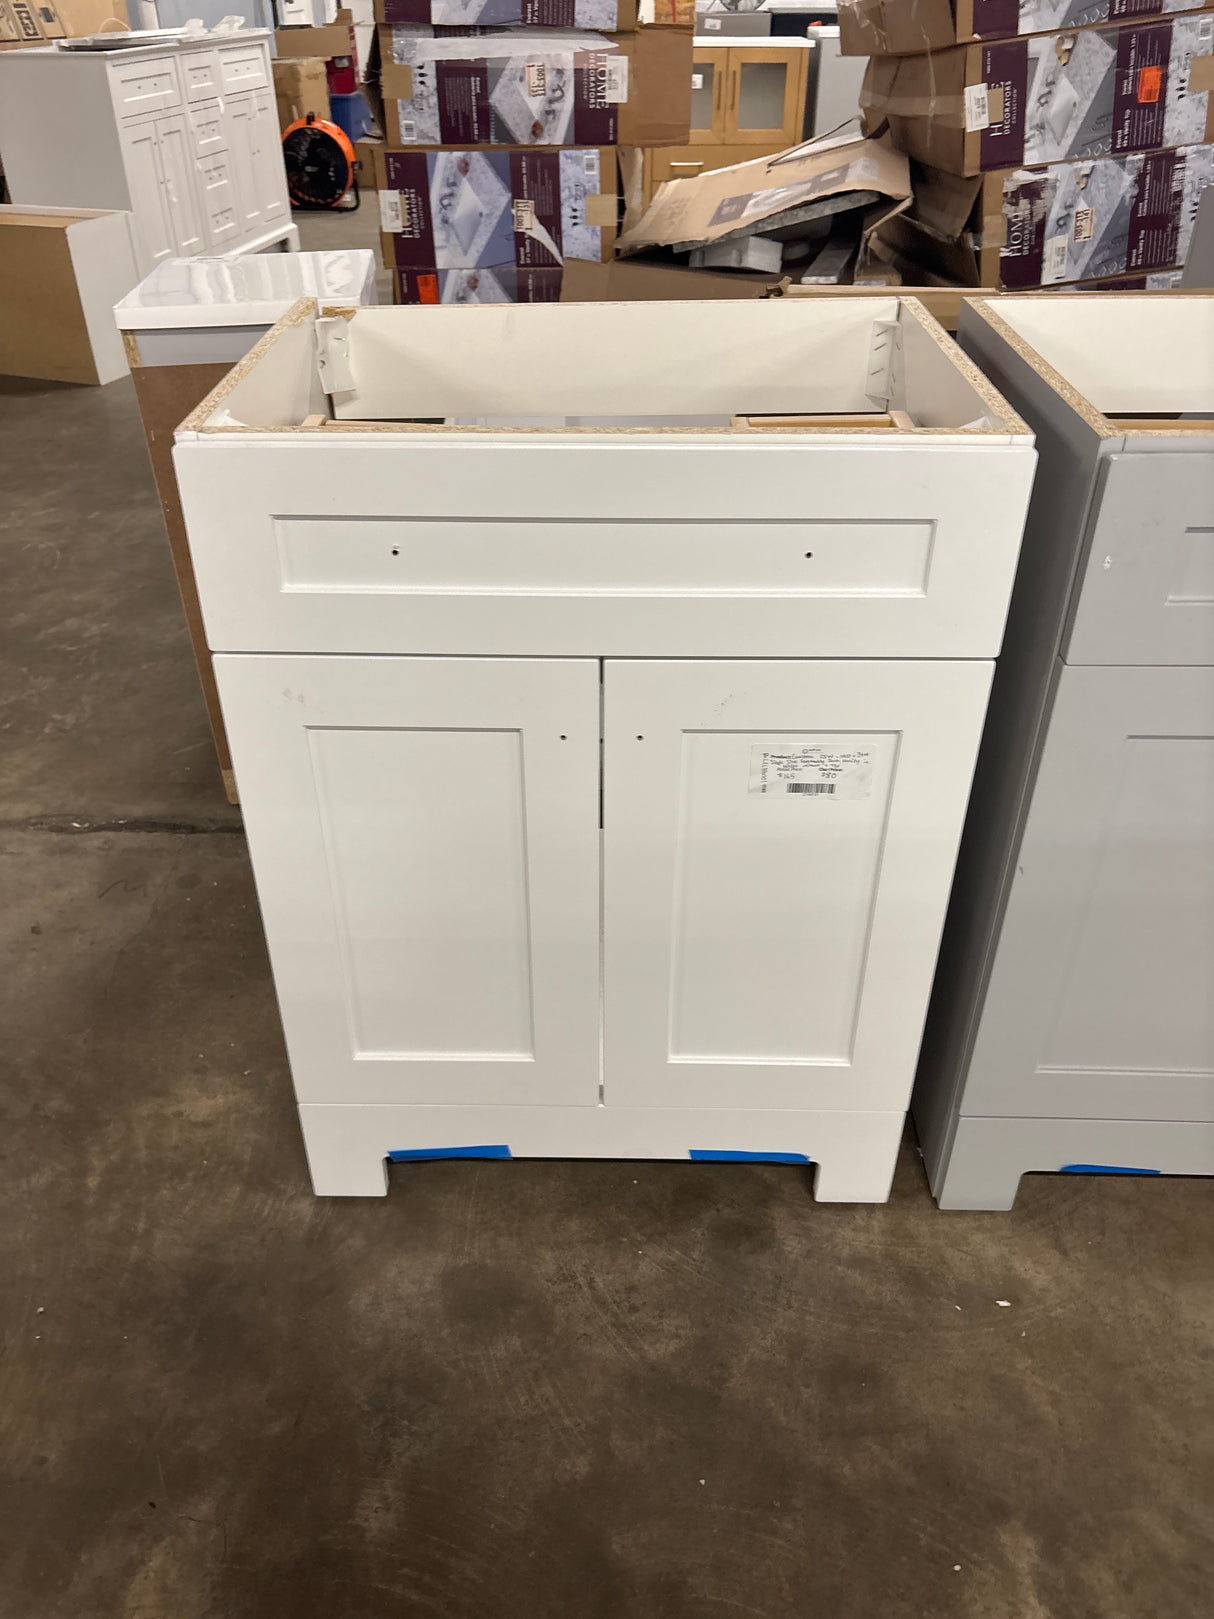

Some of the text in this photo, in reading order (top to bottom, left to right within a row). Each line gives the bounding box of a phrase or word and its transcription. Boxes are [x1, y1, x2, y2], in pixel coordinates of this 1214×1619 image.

[588, 52, 596, 109] DECORATORS
[1003, 80, 1012, 135] DECORATORS
[409, 188, 421, 239] DECORATORS
